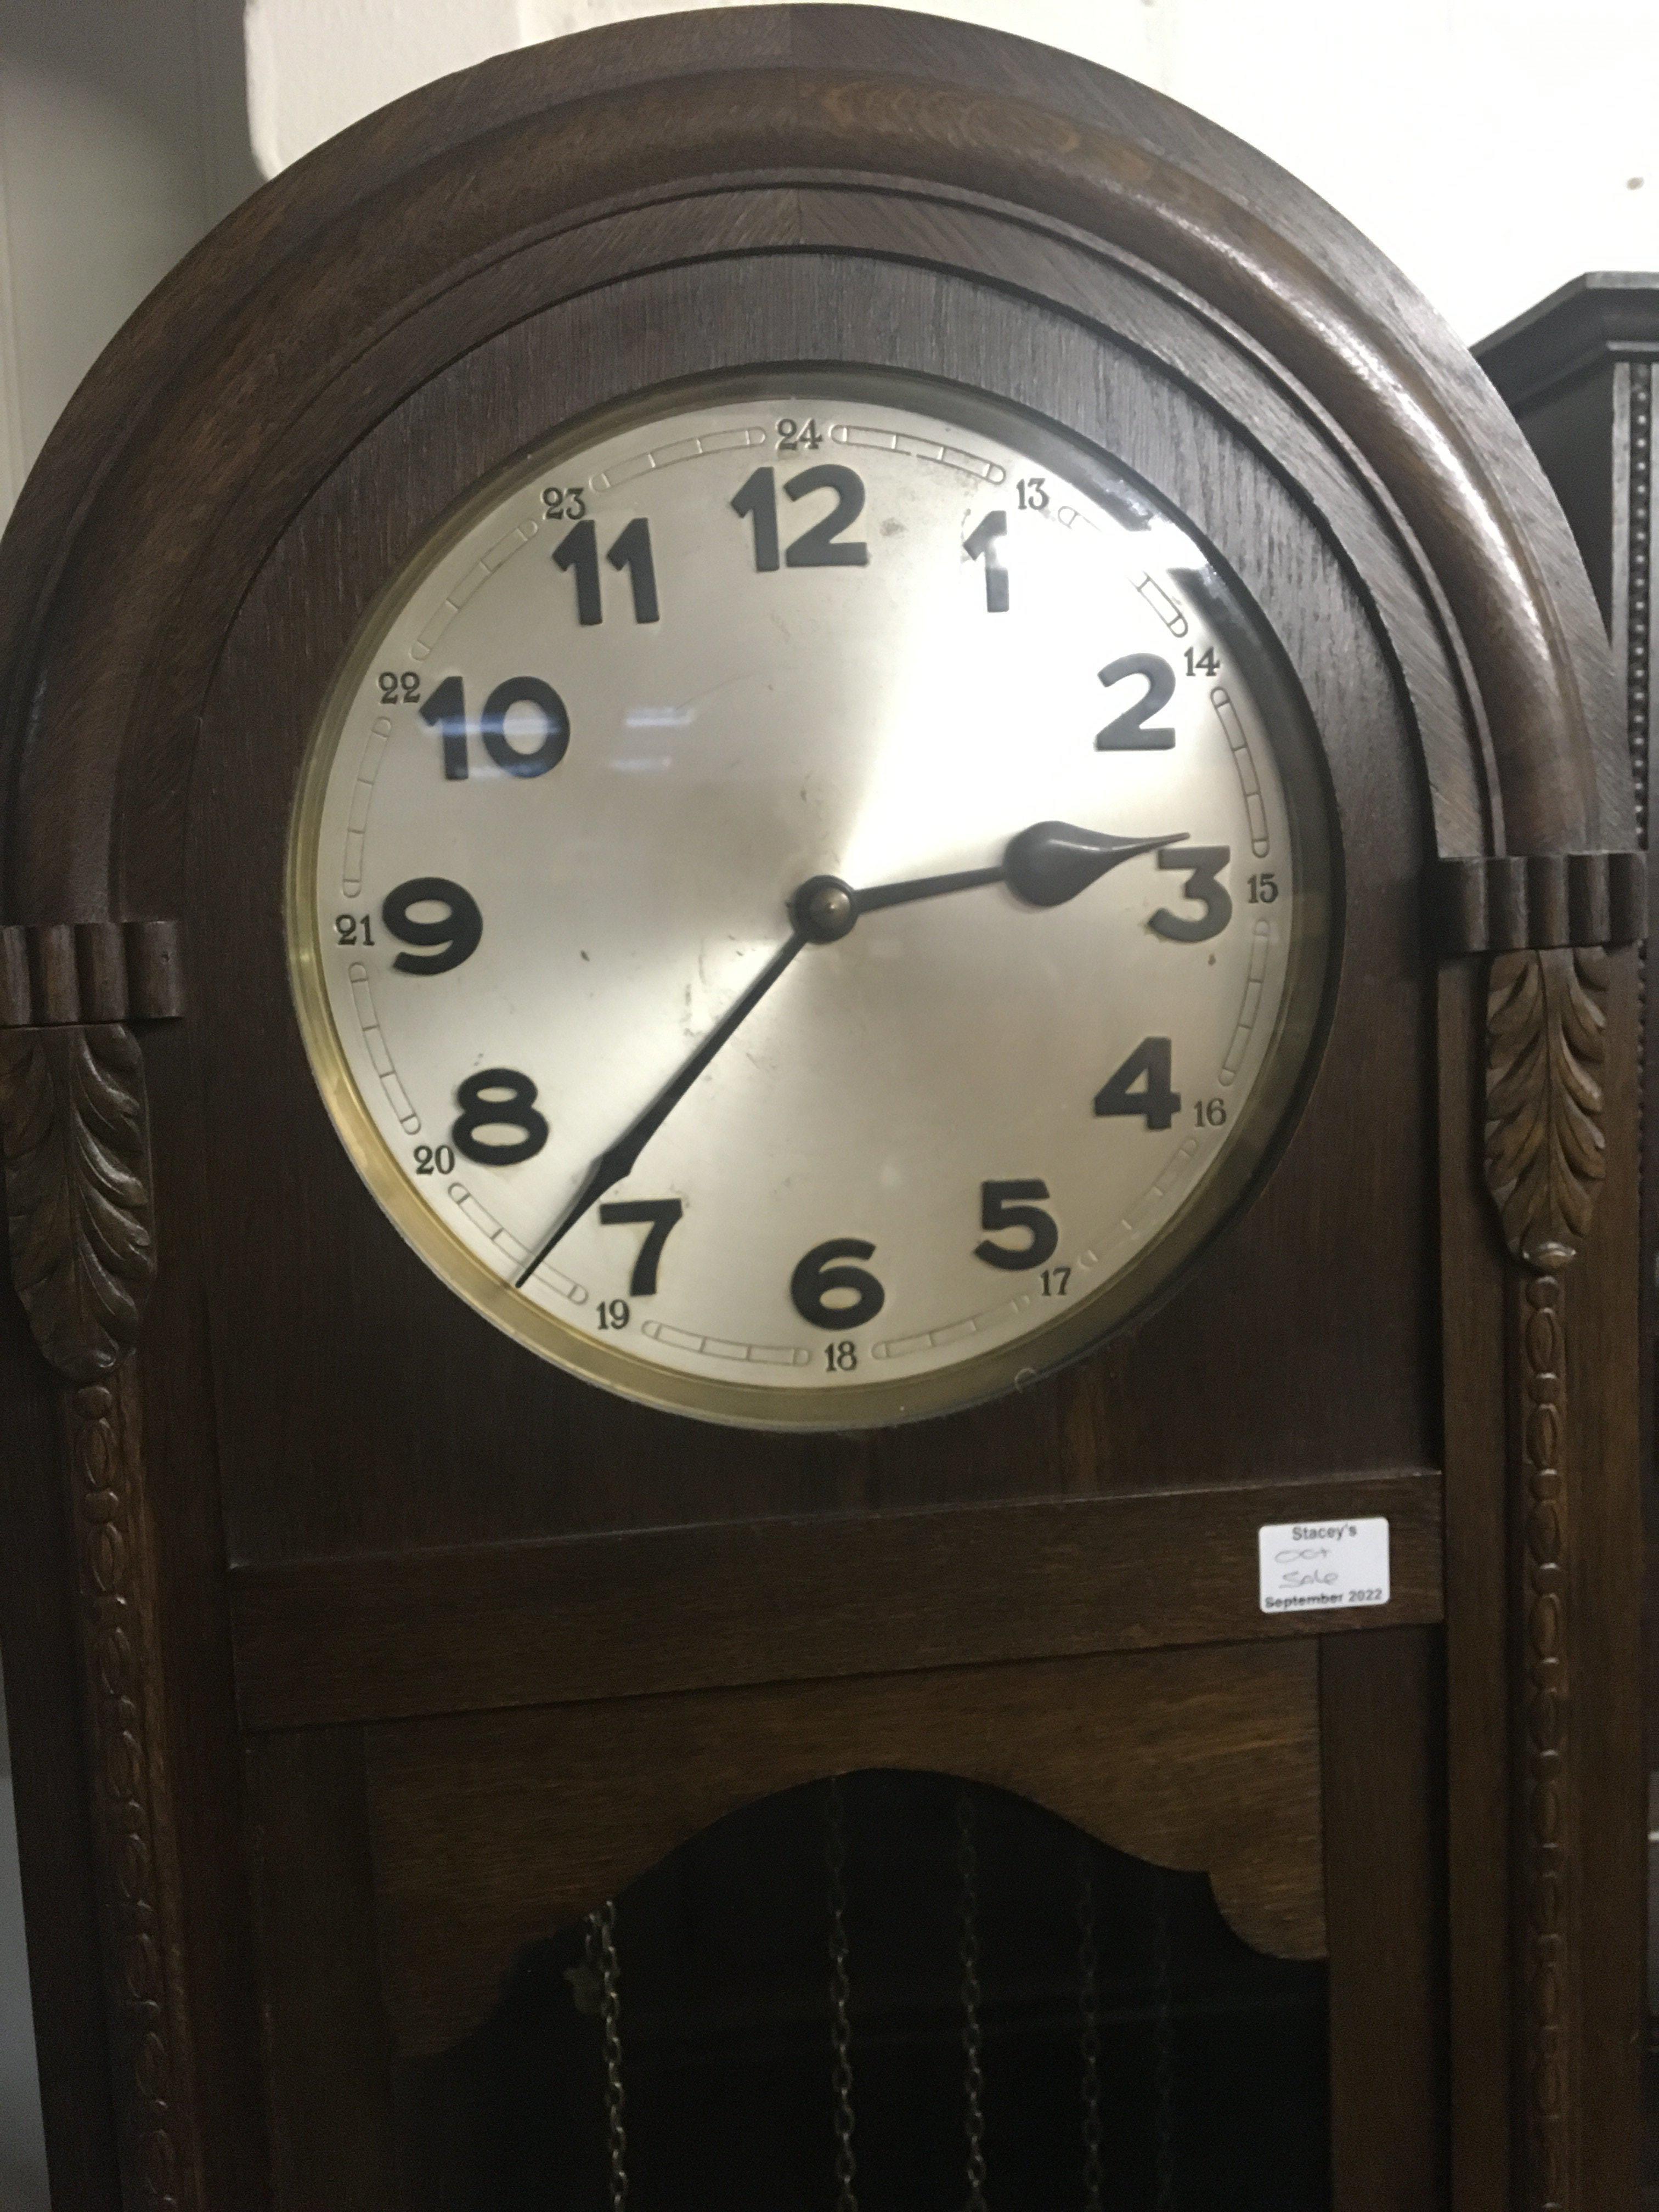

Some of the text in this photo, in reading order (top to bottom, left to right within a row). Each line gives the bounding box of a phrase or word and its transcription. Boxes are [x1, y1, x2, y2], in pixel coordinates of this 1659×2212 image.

[776, 418, 821, 451] 24
[541, 487, 586, 520] 23
[1016, 478, 1050, 510] 13
[730, 464, 868, 573] 12
[551, 517, 660, 626] 11
[963, 510, 1009, 613] 1
[1183, 646, 1221, 677] 14
[379, 672, 421, 704] 22
[1095, 653, 1176, 752] 2
[418, 675, 570, 781] 10
[1148, 845, 1233, 943] 3
[1247, 874, 1279, 904] 15
[335, 914, 375, 947] 21
[382, 877, 483, 975] 9
[1093, 1036, 1181, 1131] 4
[453, 1068, 550, 1167] 8
[1193, 1098, 1227, 1128] 16
[413, 1144, 455, 1176] 20
[974, 1178, 1058, 1272] 5
[599, 1198, 683, 1297] 7
[790, 1238, 885, 1331] 6
[1040, 1267, 1071, 1297] 17
[597, 1299, 630, 1330] 19
[825, 1340, 857, 1372] 18
[1292, 1523, 1357, 1541] Stacey's
[1265, 1588, 1383, 1610] September 2022
